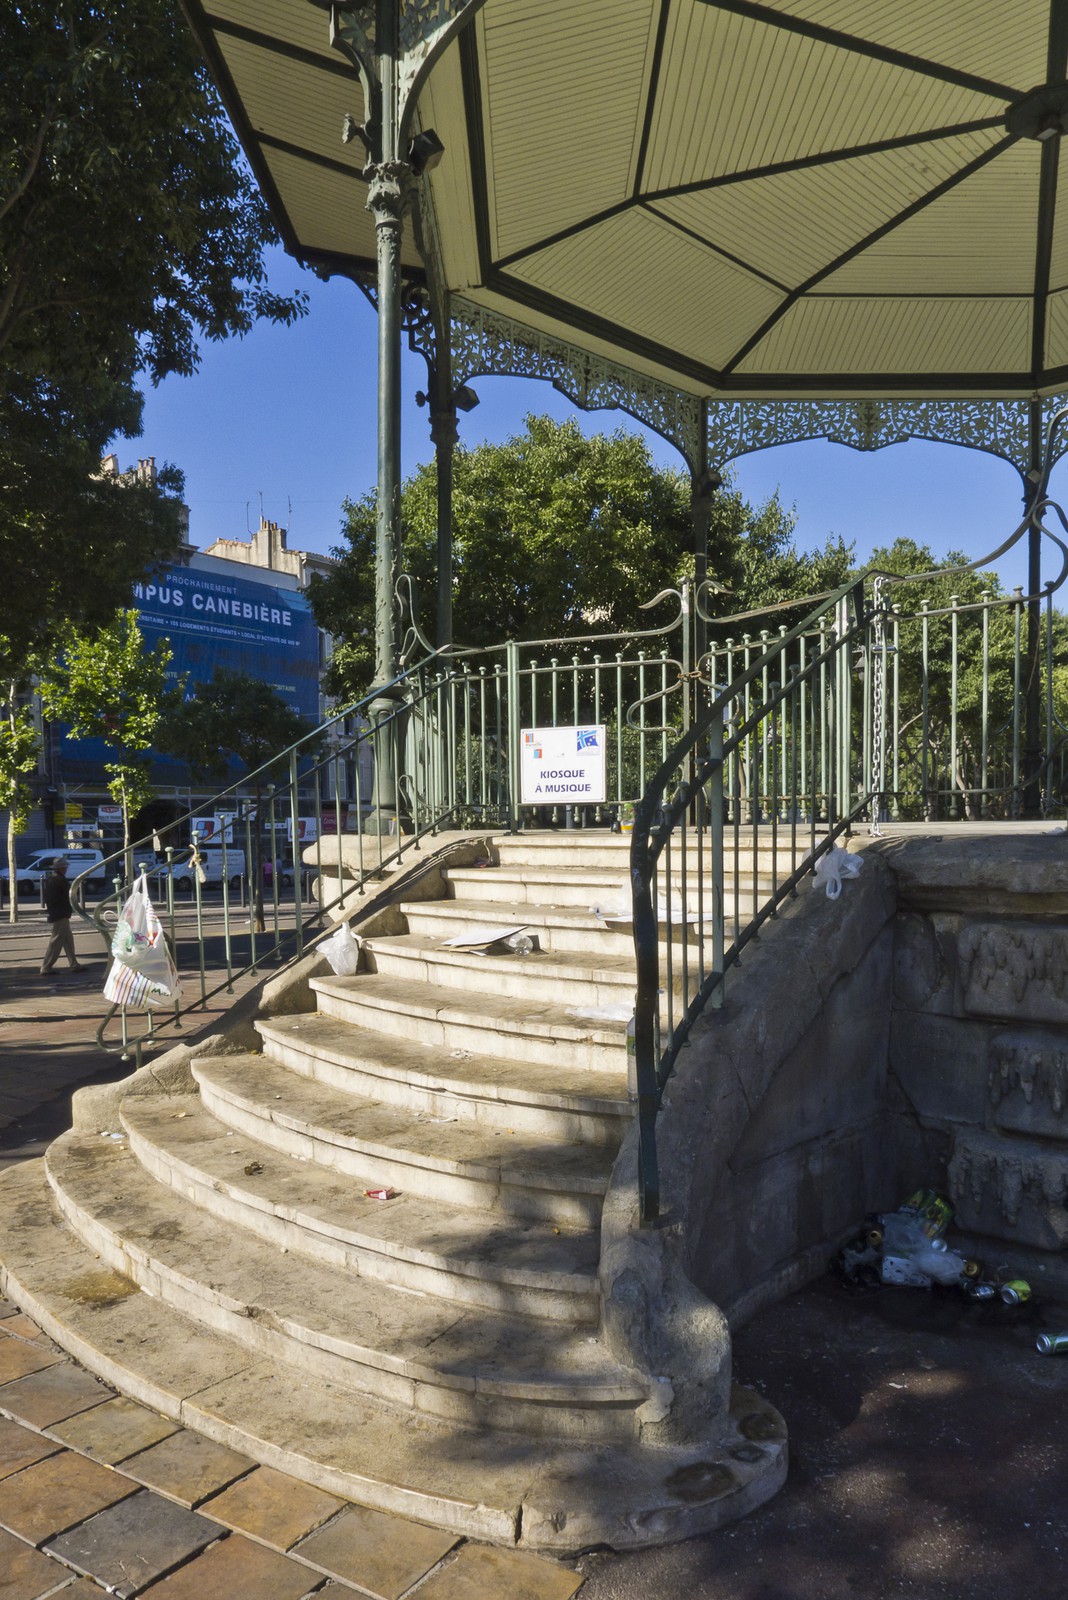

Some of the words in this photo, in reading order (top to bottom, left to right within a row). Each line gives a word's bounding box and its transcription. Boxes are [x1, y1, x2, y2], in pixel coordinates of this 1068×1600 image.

[166, 574, 237, 595] PROCHAINEMENT
[132, 582, 184, 607] MPUS
[191, 593, 292, 627] CANEBIÈRE
[540, 769, 585, 779] KIOSQUE
[535, 782, 542, 793] À
[545, 783, 591, 793] MUSIQUE
